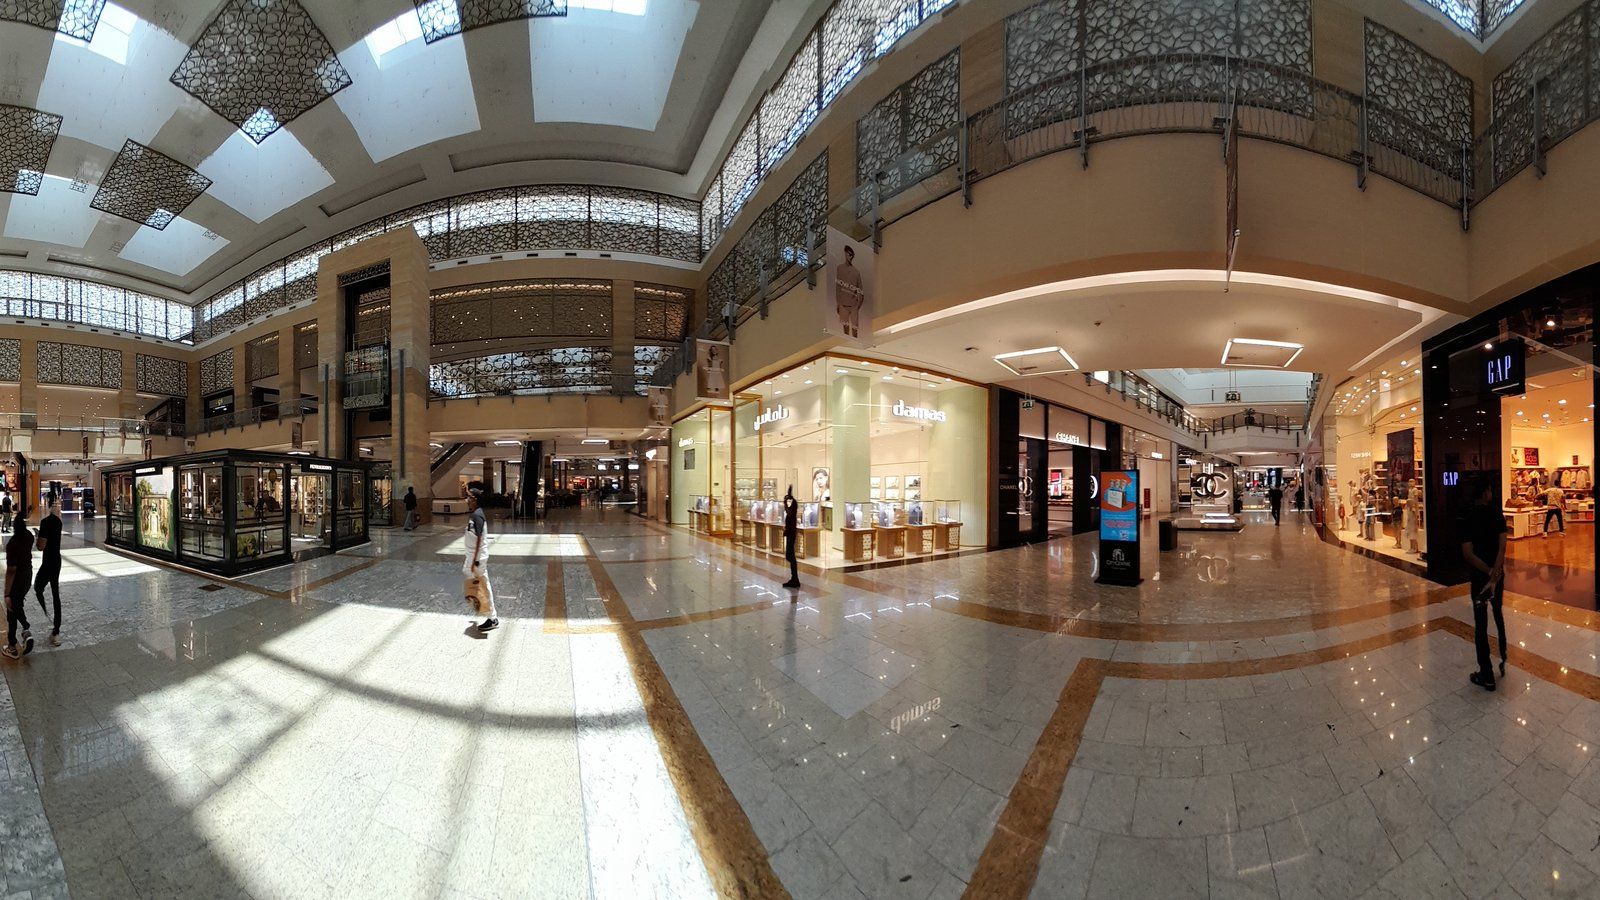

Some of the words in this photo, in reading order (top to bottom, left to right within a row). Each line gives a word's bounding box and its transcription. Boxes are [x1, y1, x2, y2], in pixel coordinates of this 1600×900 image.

[1488, 355, 1511, 384] GAP
[753, 404, 789, 430] داماس
[892, 400, 946, 421] damas
[1443, 471, 1459, 486] GAP
